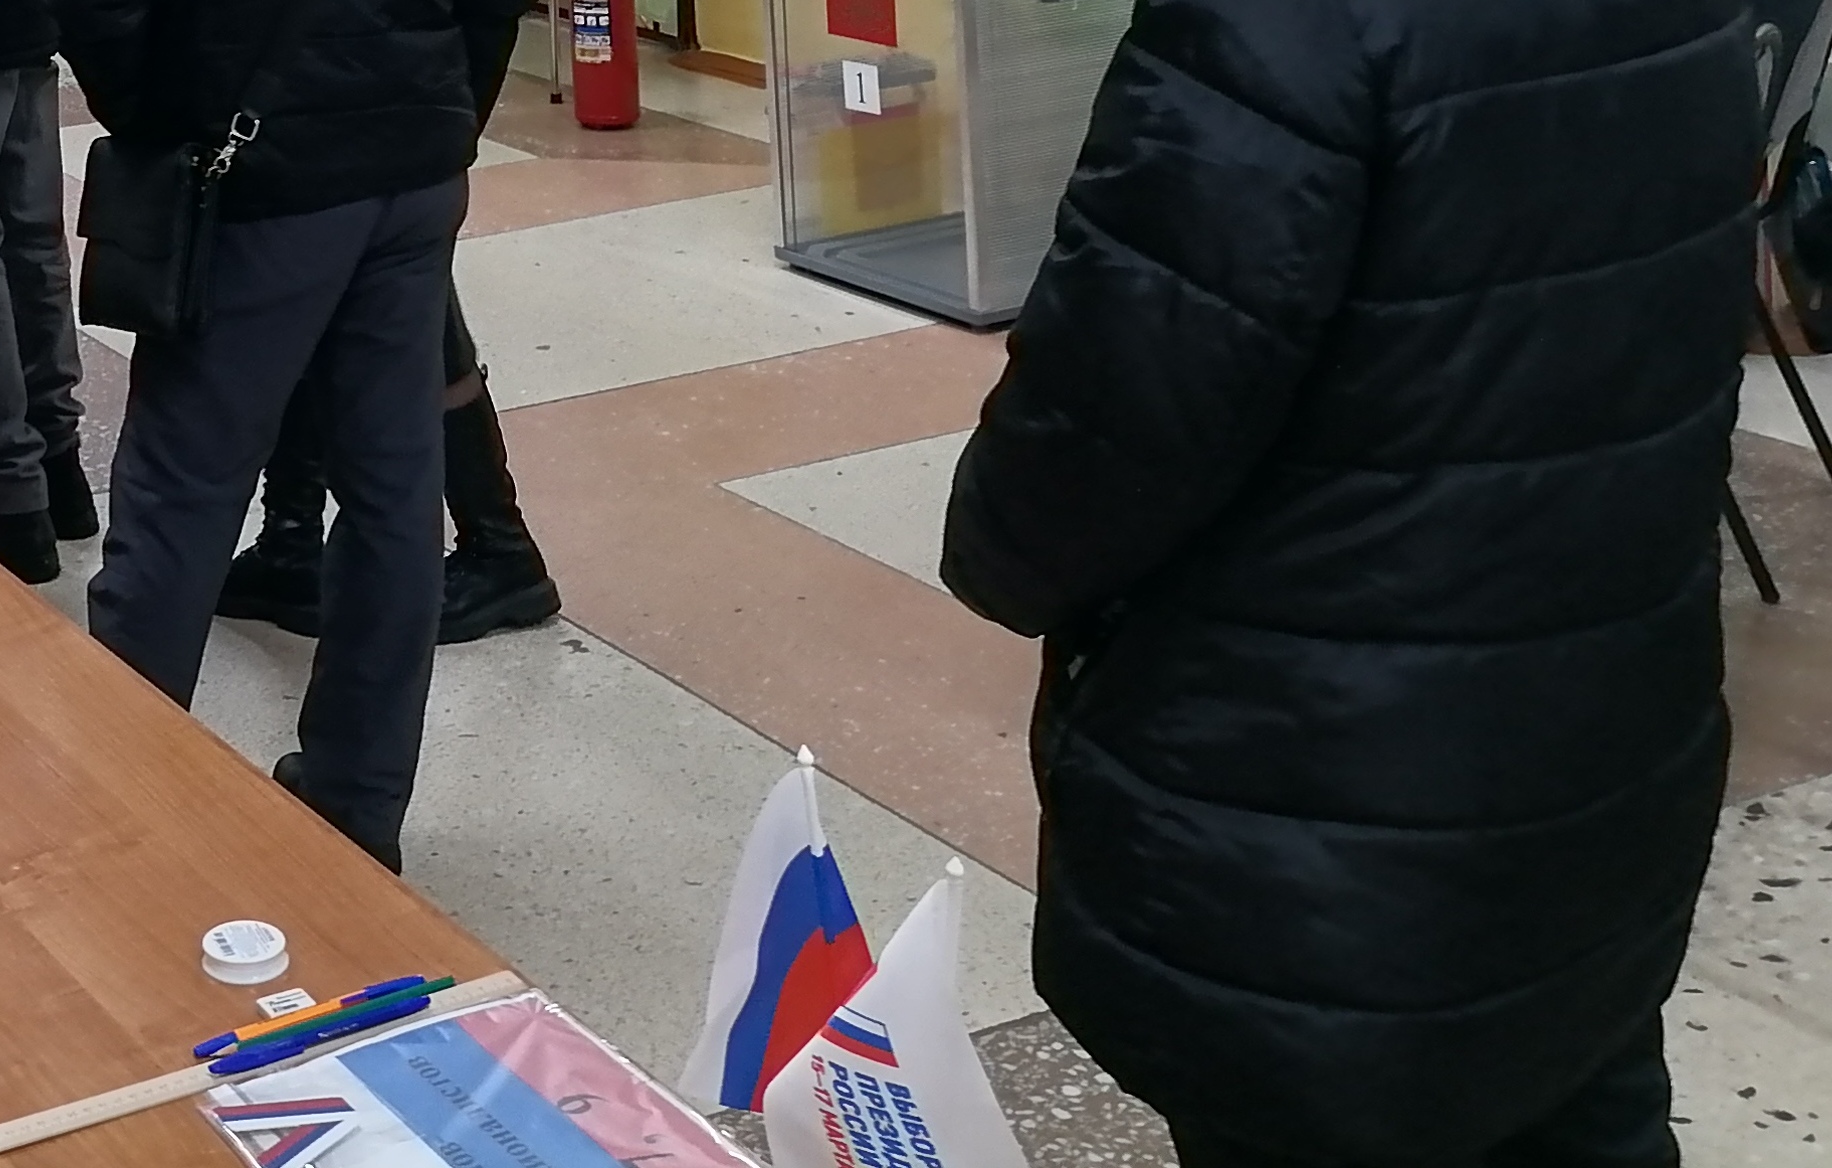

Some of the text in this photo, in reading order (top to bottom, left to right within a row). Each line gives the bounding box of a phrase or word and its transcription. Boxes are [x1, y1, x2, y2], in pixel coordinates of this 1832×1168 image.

[856, 71, 866, 104] 1
[407, 1055, 553, 1168] ионалистов
[557, 1093, 610, 1115] 9
[828, 1060, 883, 1168] РОССИИ
